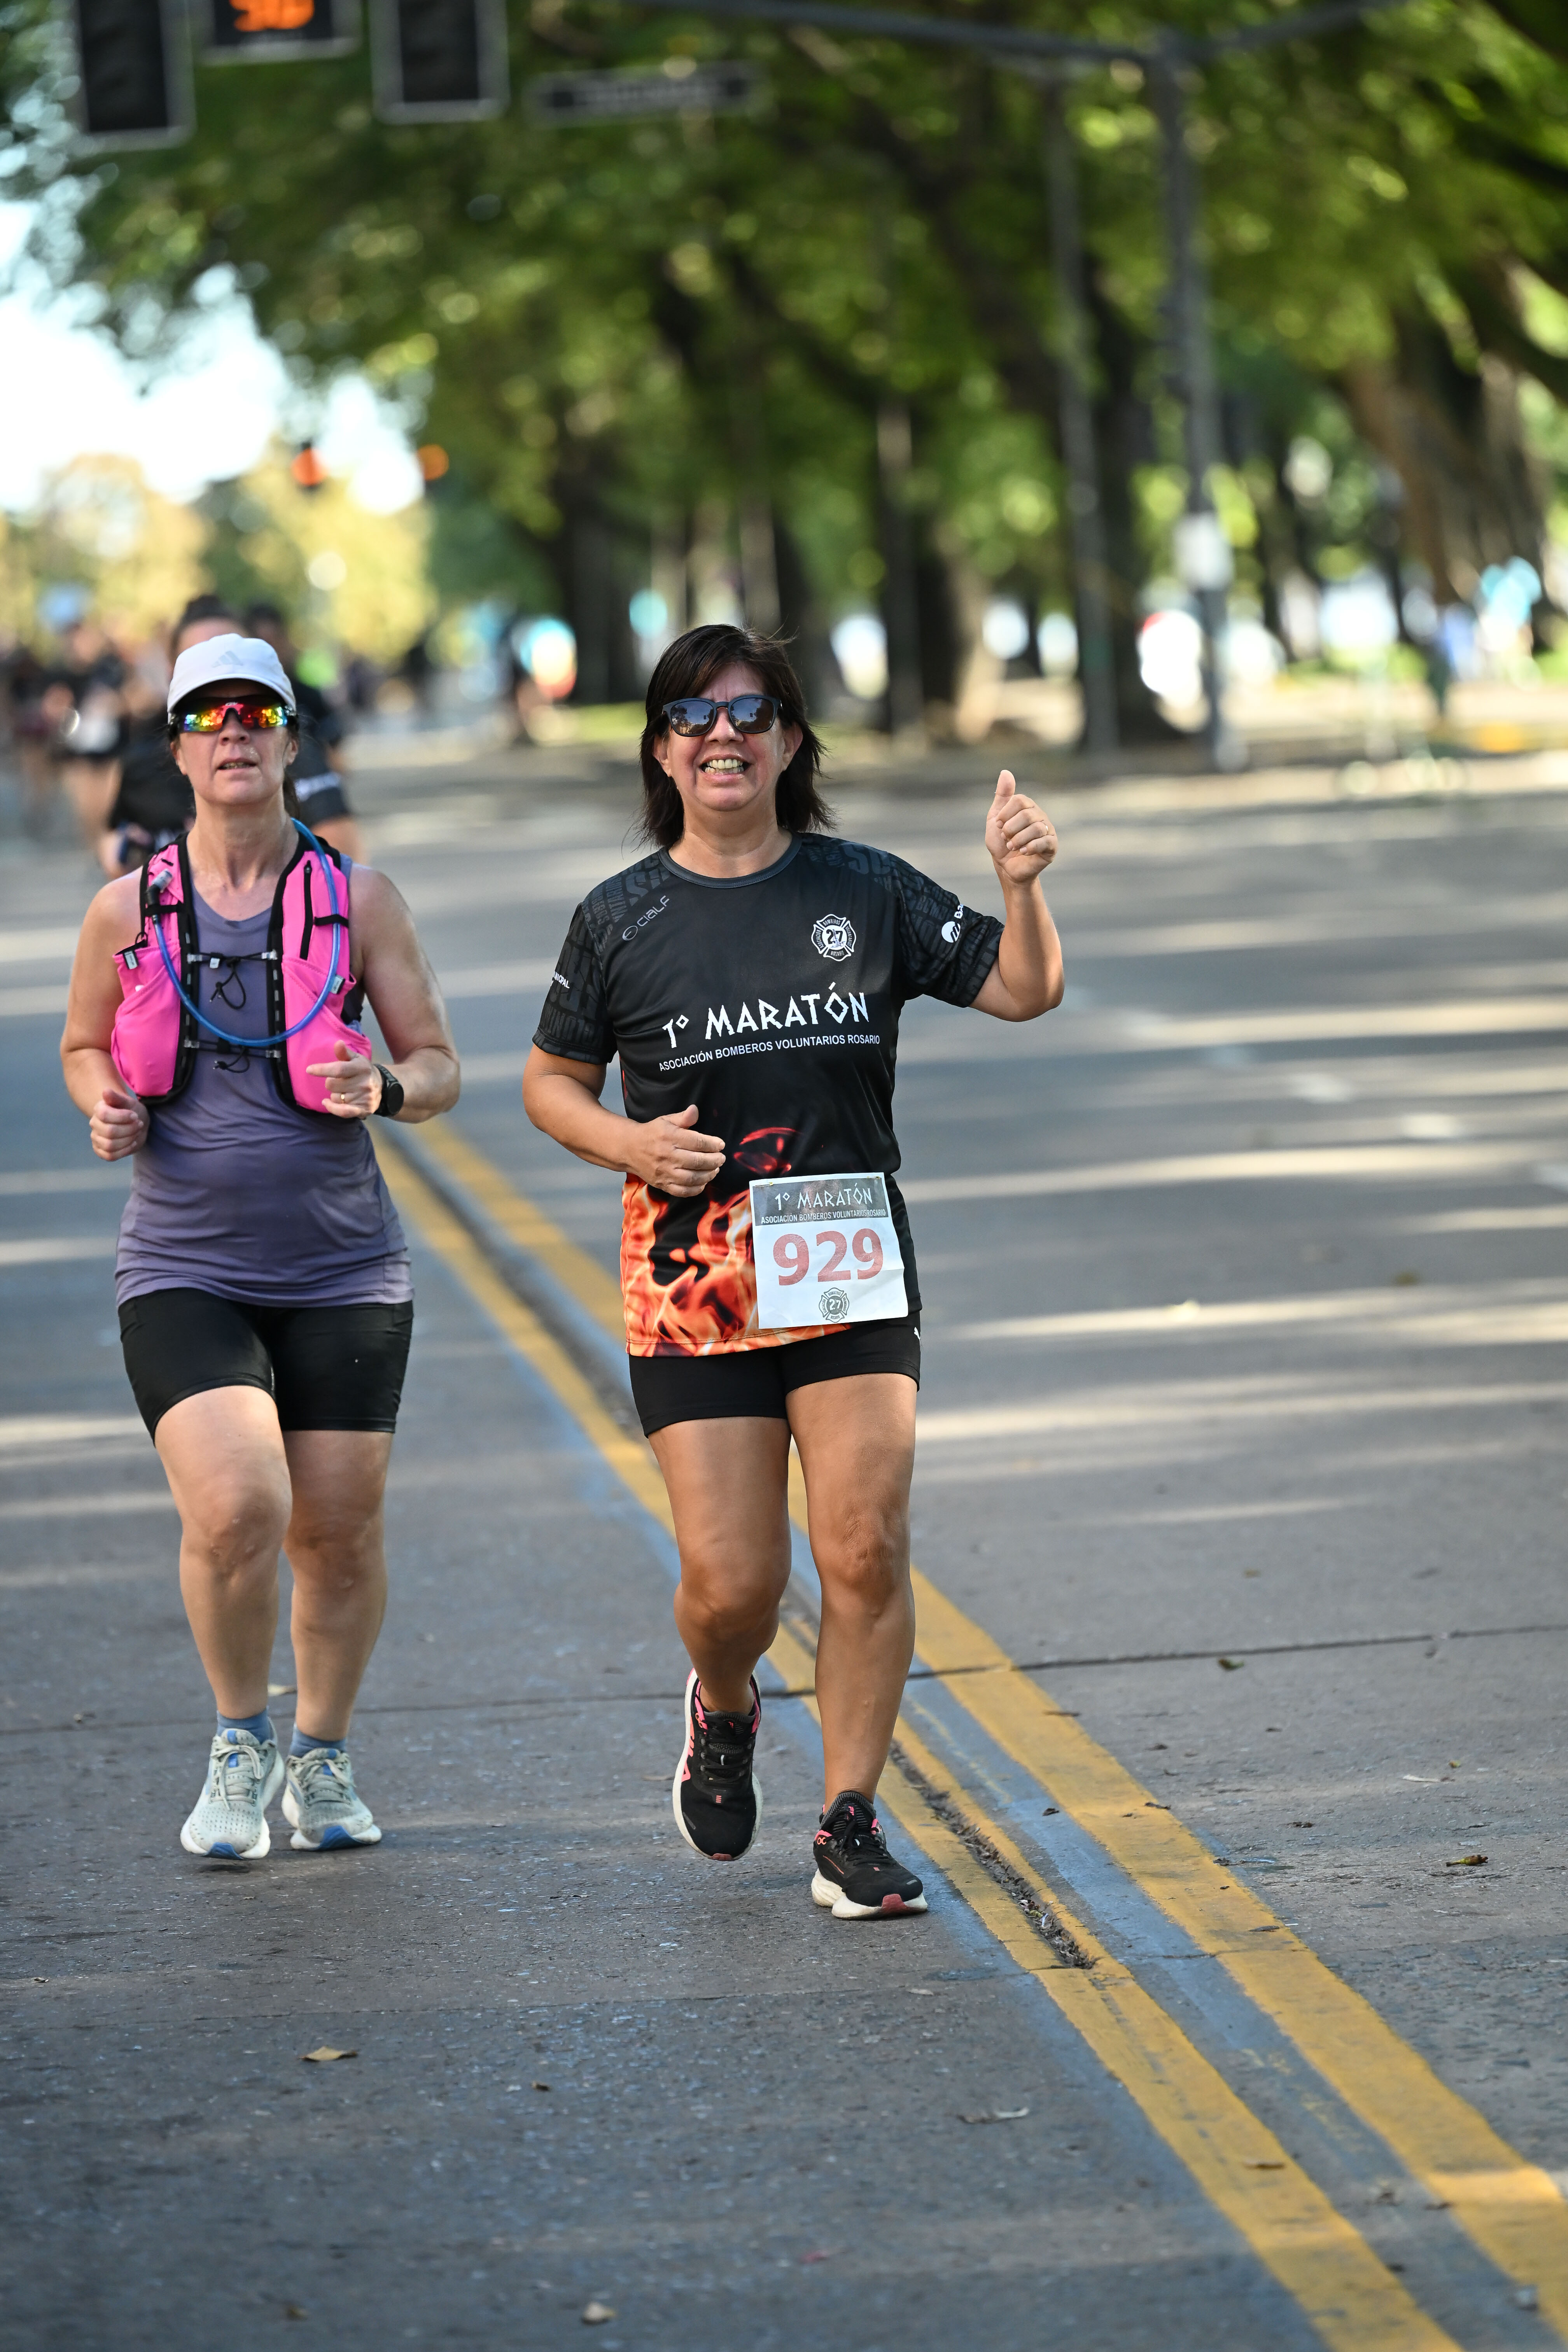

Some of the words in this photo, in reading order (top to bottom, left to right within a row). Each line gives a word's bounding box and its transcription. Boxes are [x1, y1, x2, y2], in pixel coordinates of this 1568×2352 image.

[826, 929, 843, 945] 27
[705, 981, 869, 1040] MARATÓN
[659, 1050, 713, 1072] ASOCIACIÓN
[715, 1041, 773, 1059] BOMBEROS
[775, 1035, 845, 1050] VOLUNTARIOS
[848, 1034, 880, 1045] ROSARIO
[797, 1182, 873, 1209] MARATÓN
[761, 1213, 798, 1224] ASOCIACIÓN
[799, 1211, 831, 1221] BOMBEROS
[833, 1209, 867, 1219] VOLUNTARIOS
[867, 1209, 886, 1217] ROSARIO
[773, 1228, 884, 1286] 929
[829, 1298, 841, 1311] 27
